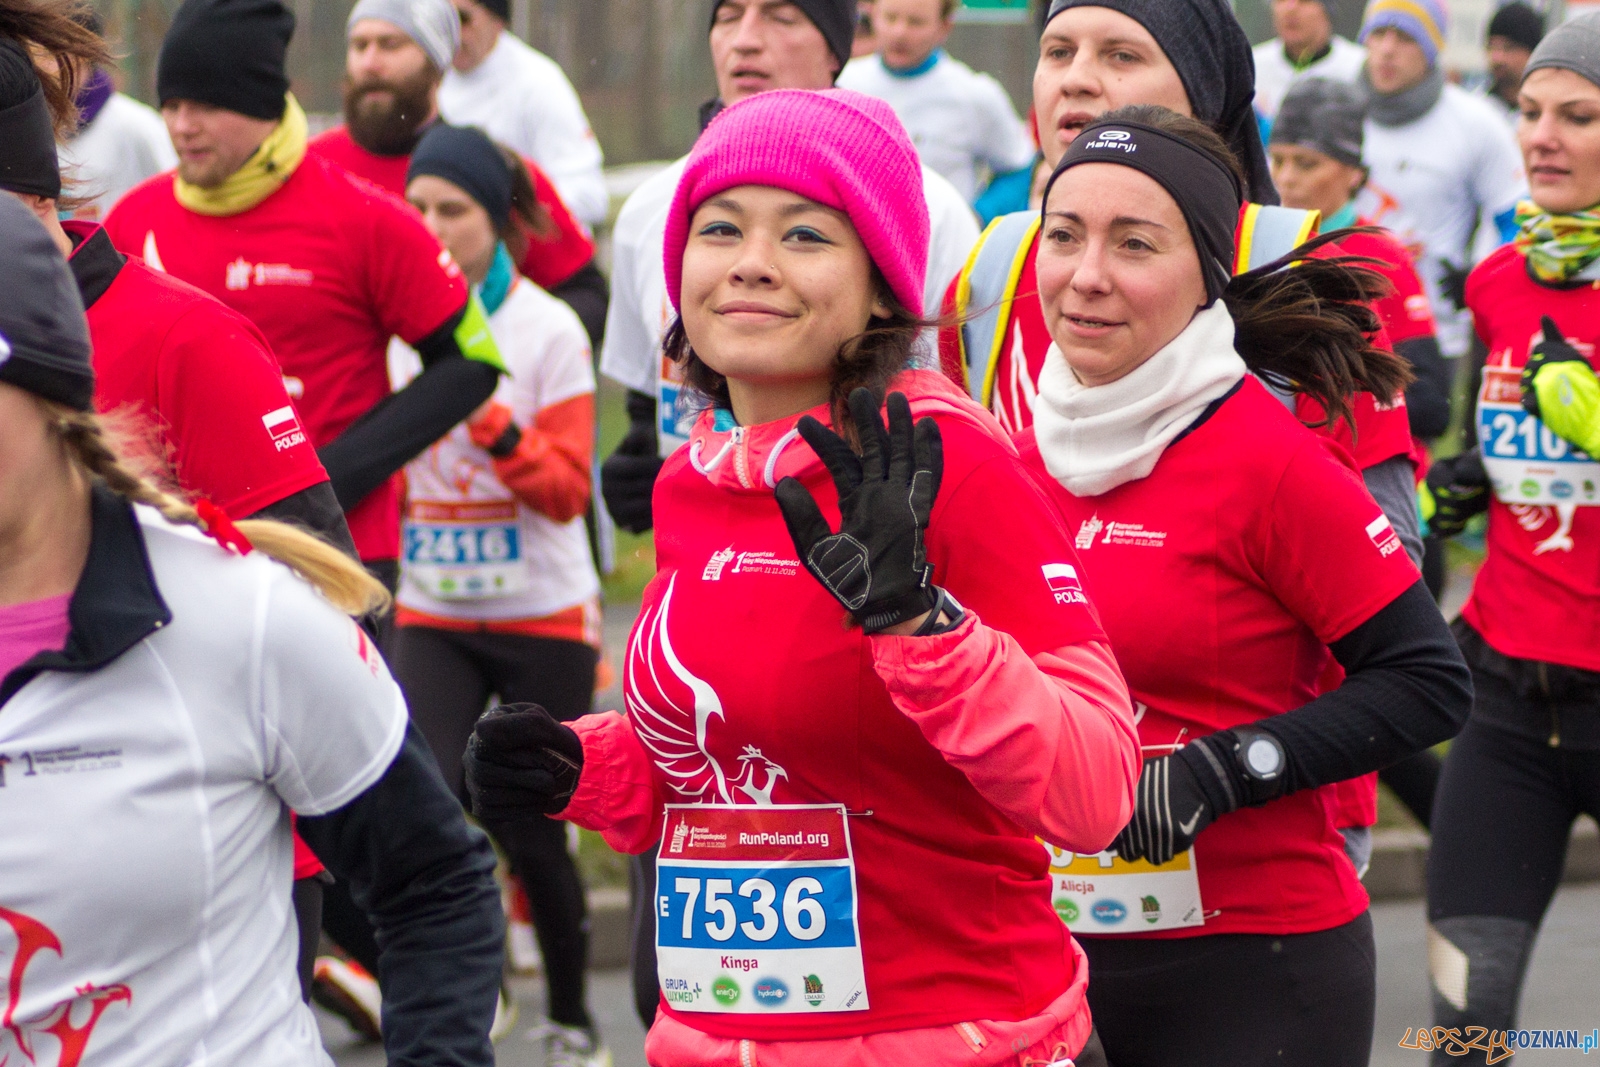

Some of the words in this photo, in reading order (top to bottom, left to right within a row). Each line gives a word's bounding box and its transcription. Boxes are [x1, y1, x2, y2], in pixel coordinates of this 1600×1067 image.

[274, 431, 306, 453] POLSKA
[1493, 412, 1589, 460] 210
[414, 527, 511, 561] 2416
[731, 551, 747, 573] 1
[739, 831, 830, 847] RunPoland.org
[1060, 880, 1095, 895] Alicja
[659, 895, 670, 917] E
[674, 877, 827, 942] 7536
[720, 956, 759, 972] Kinga
[665, 978, 689, 991] GRUPA
[846, 990, 862, 1008] ROGAL
